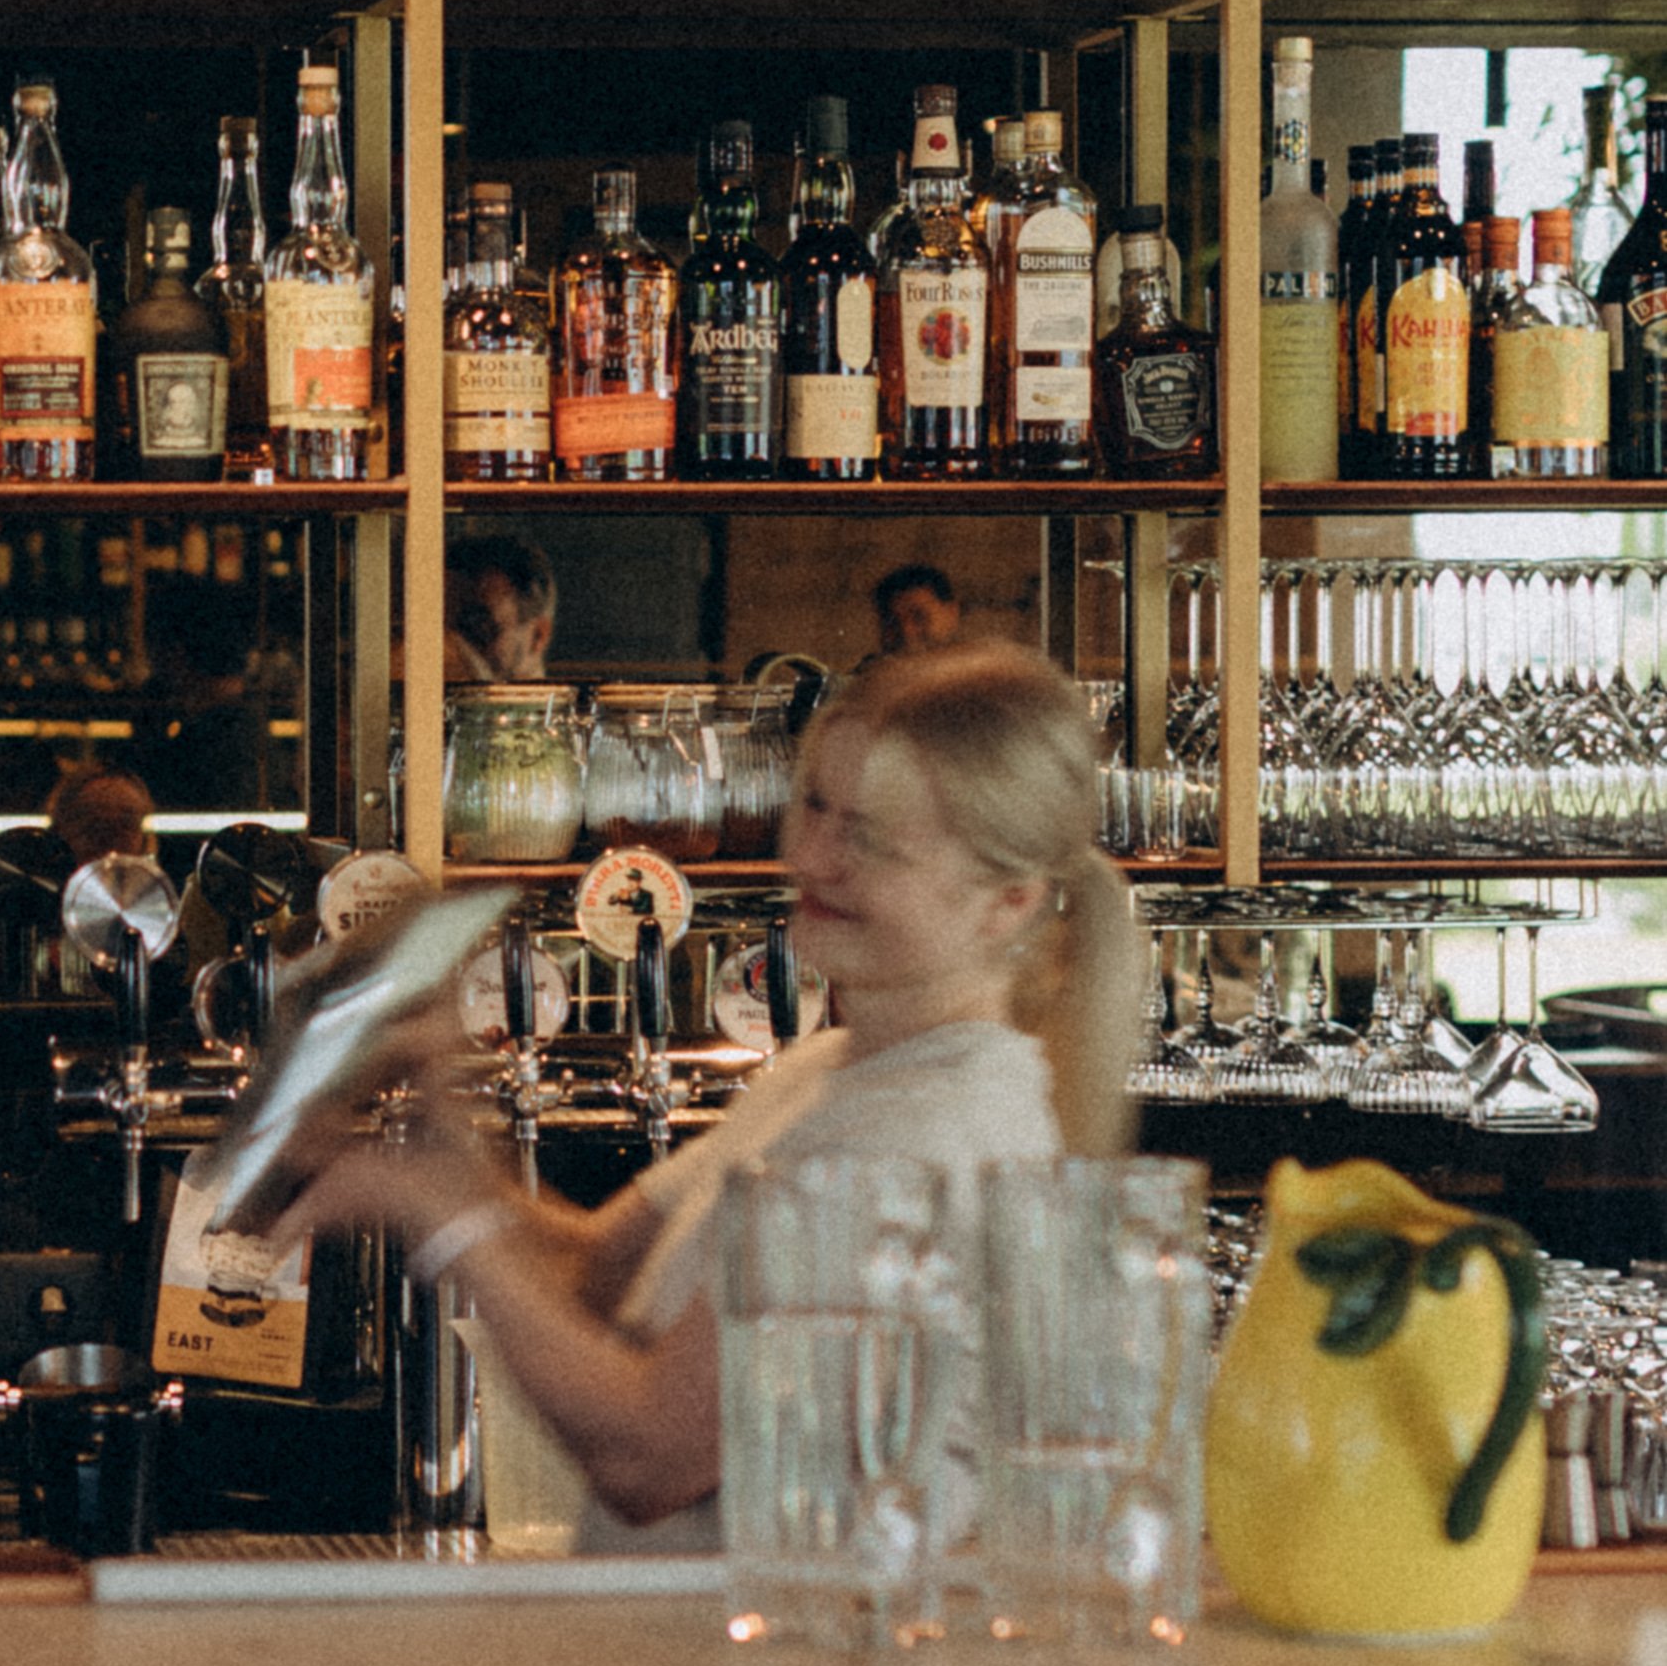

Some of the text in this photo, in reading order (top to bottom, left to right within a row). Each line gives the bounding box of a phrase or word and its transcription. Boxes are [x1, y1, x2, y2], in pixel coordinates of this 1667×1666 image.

[1019, 254, 1091, 270] BUSHMILLS
[625, 856, 682, 910] MORETTI
[167, 1331, 215, 1352] EAST
